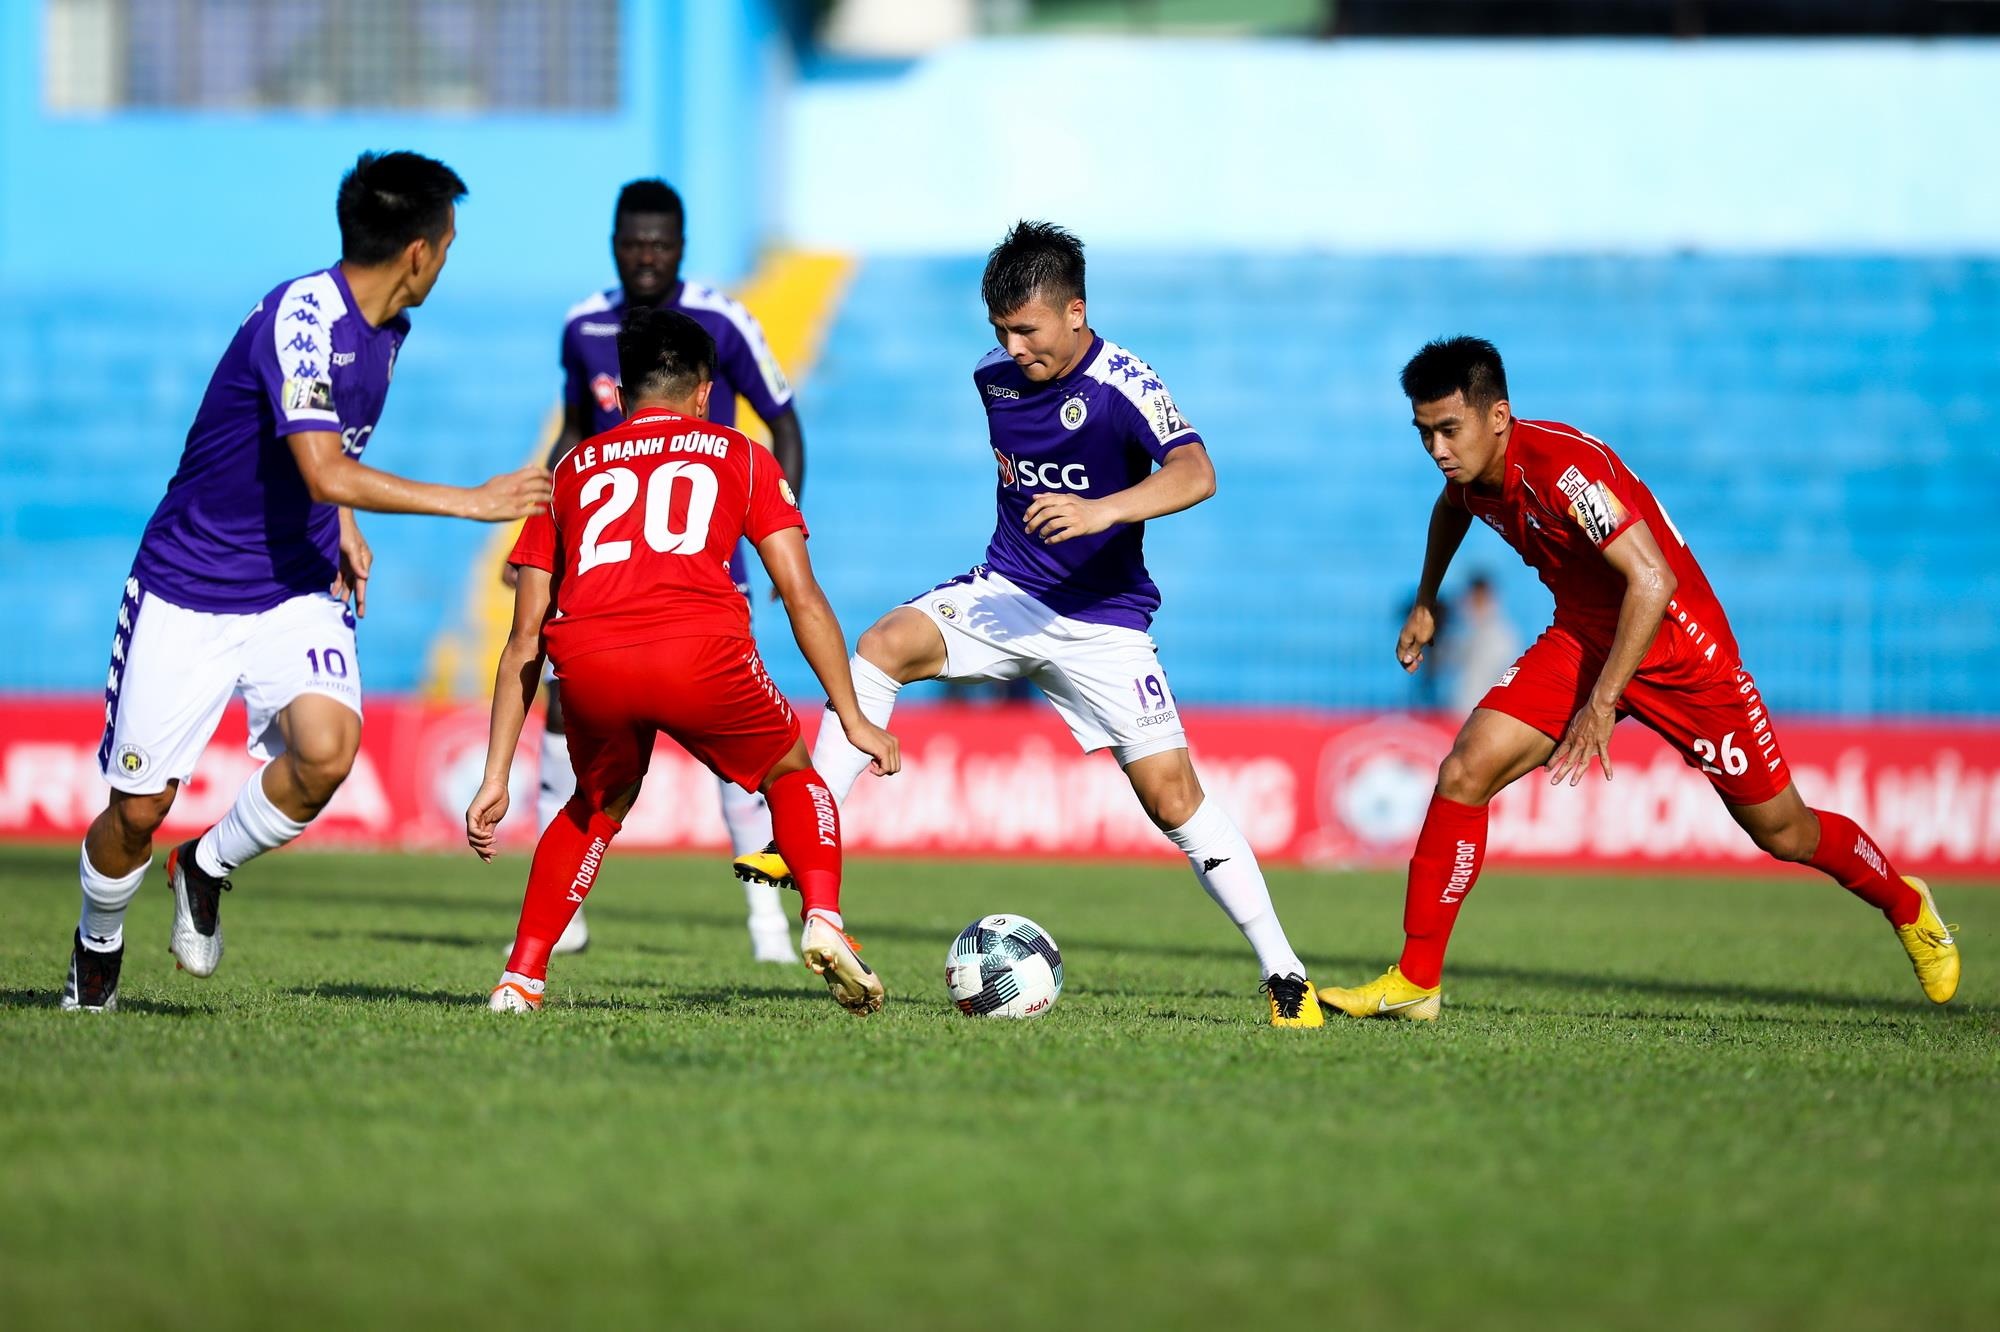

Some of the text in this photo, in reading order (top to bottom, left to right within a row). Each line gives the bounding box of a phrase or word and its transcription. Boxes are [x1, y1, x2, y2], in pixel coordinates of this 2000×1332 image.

[987, 384, 1020, 400] Kappa
[573, 430, 730, 474] LÊ MẠNH DŨNG
[1017, 460, 1090, 491] SCG
[577, 460, 719, 576] 20
[306, 648, 347, 679] 10
[1133, 674, 1166, 714] 19
[1136, 710, 1175, 728] Kappa
[1693, 731, 1749, 776] 26
[1439, 839, 1477, 904] JOGARBOLA
[1024, 997, 1049, 1014] VPF
